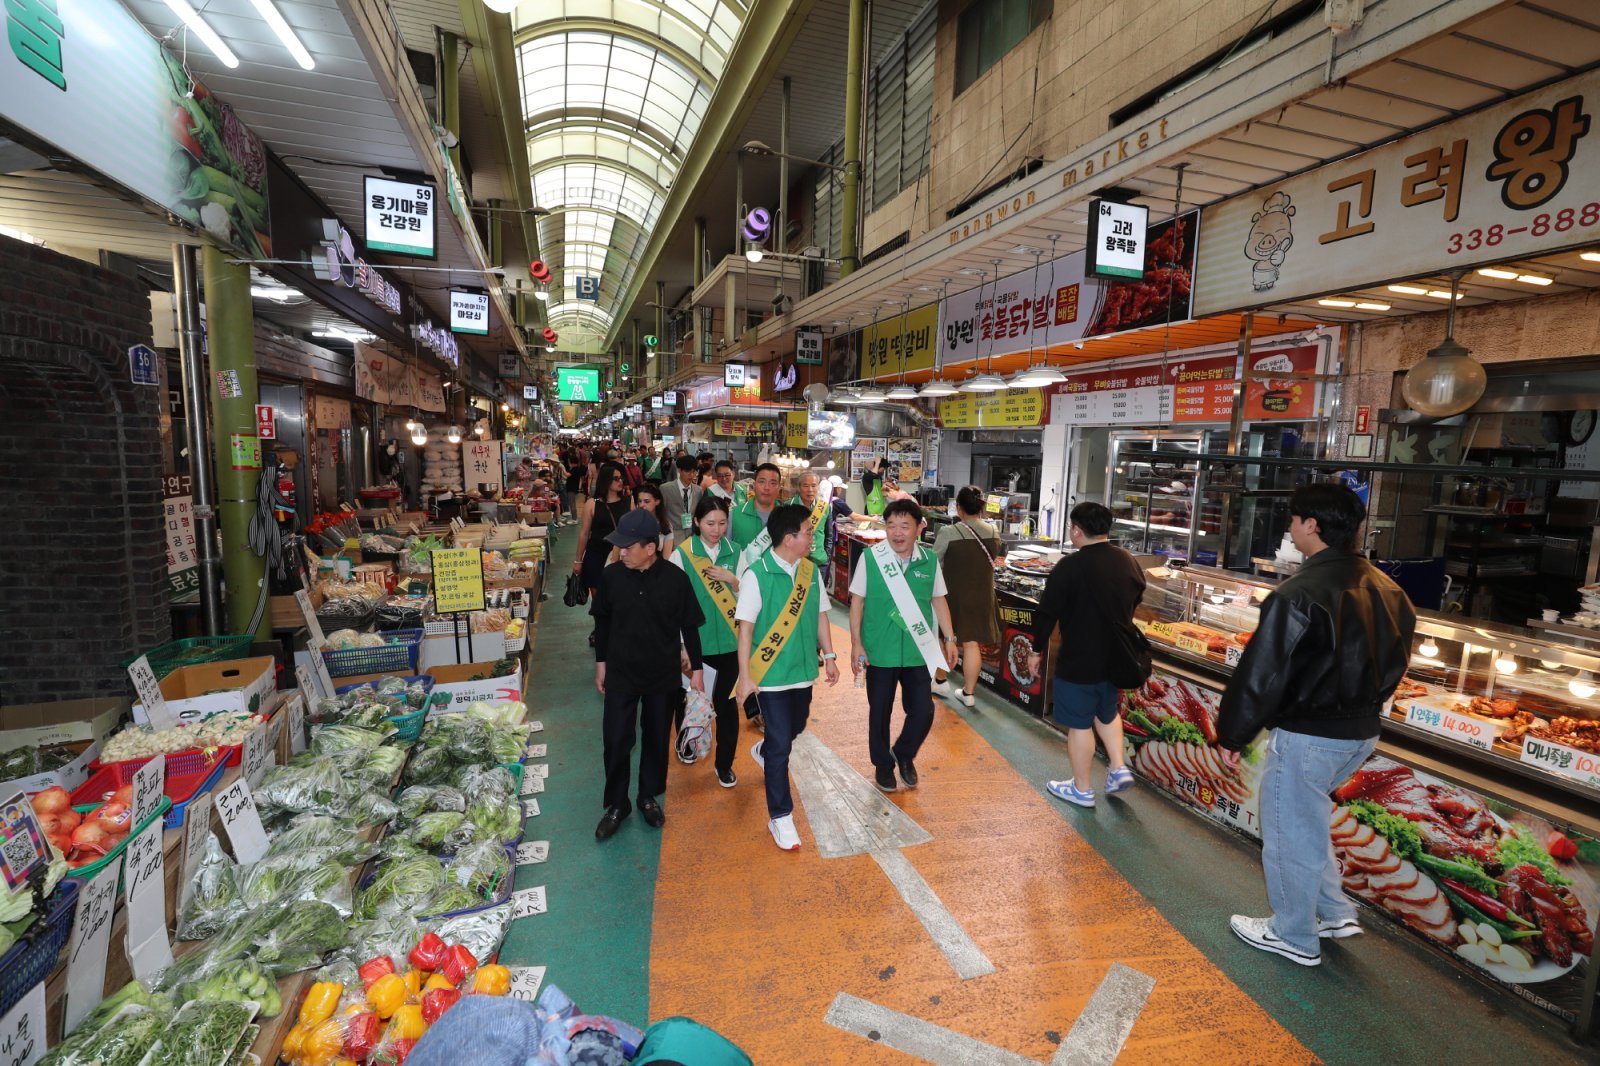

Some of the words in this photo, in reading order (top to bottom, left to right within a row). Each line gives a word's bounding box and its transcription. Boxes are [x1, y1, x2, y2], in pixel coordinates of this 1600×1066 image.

[949, 190, 1035, 244] mangwon
[1062, 117, 1169, 188] market
[416, 188, 431, 200] 59
[371, 194, 429, 216] 옹기마을
[1100, 204, 1112, 217] 64
[379, 213, 421, 232] 건강원
[1111, 219, 1133, 236] 고려
[1105, 236, 1137, 254] 왕족발
[580, 277, 594, 294] B
[1059, 286, 1077, 303] 포장
[1057, 304, 1076, 321] 배달
[946, 316, 974, 350] 망원
[980, 295, 1054, 341] 숯불닭발
[890, 325, 930, 360] 떡갈비
[137, 351, 150, 367] 36
[471, 444, 491, 458] 새우젓
[474, 460, 488, 474] 국산
[168, 569, 200, 593] 료상
[788, 583, 806, 617] 청결
[883, 561, 898, 578] 친
[911, 620, 928, 636] 절
[1019, 611, 1032, 626] 맛!!
[1152, 622, 1173, 637] 국내산
[760, 631, 785, 663] 위생
[1409, 705, 1441, 726] 1인족발
[1442, 715, 1481, 737] 14.000
[1467, 736, 1487, 749] 국내산
[1526, 740, 1574, 769] 미니족발
[219, 783, 242, 809] 근대
